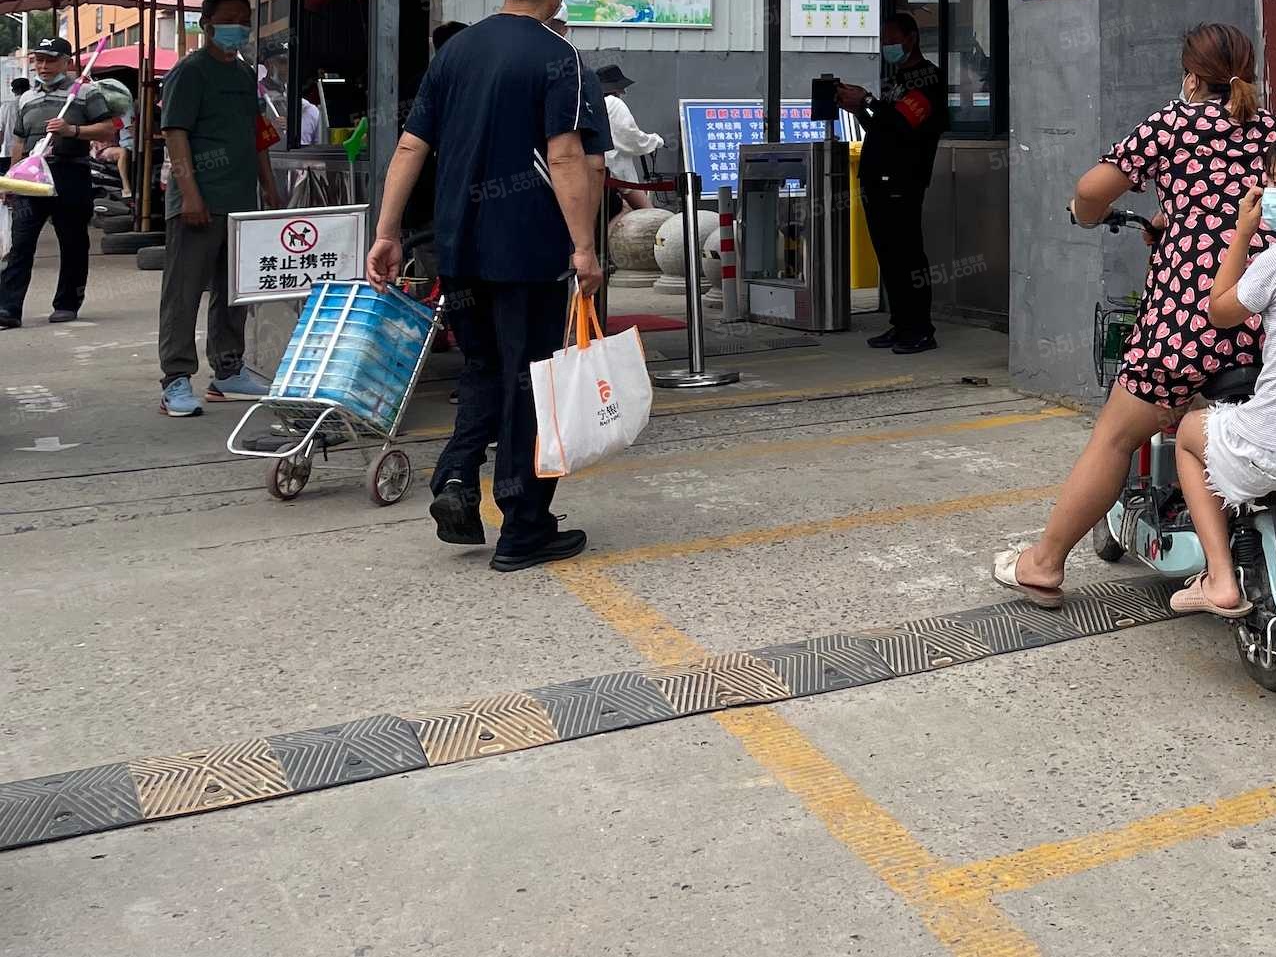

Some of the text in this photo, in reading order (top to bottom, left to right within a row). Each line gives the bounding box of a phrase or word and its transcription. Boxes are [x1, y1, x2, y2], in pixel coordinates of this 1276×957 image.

[709, 152, 739, 160] 公平交
[711, 163, 738, 171] 食品卫
[259, 252, 338, 272] 禁止携带
